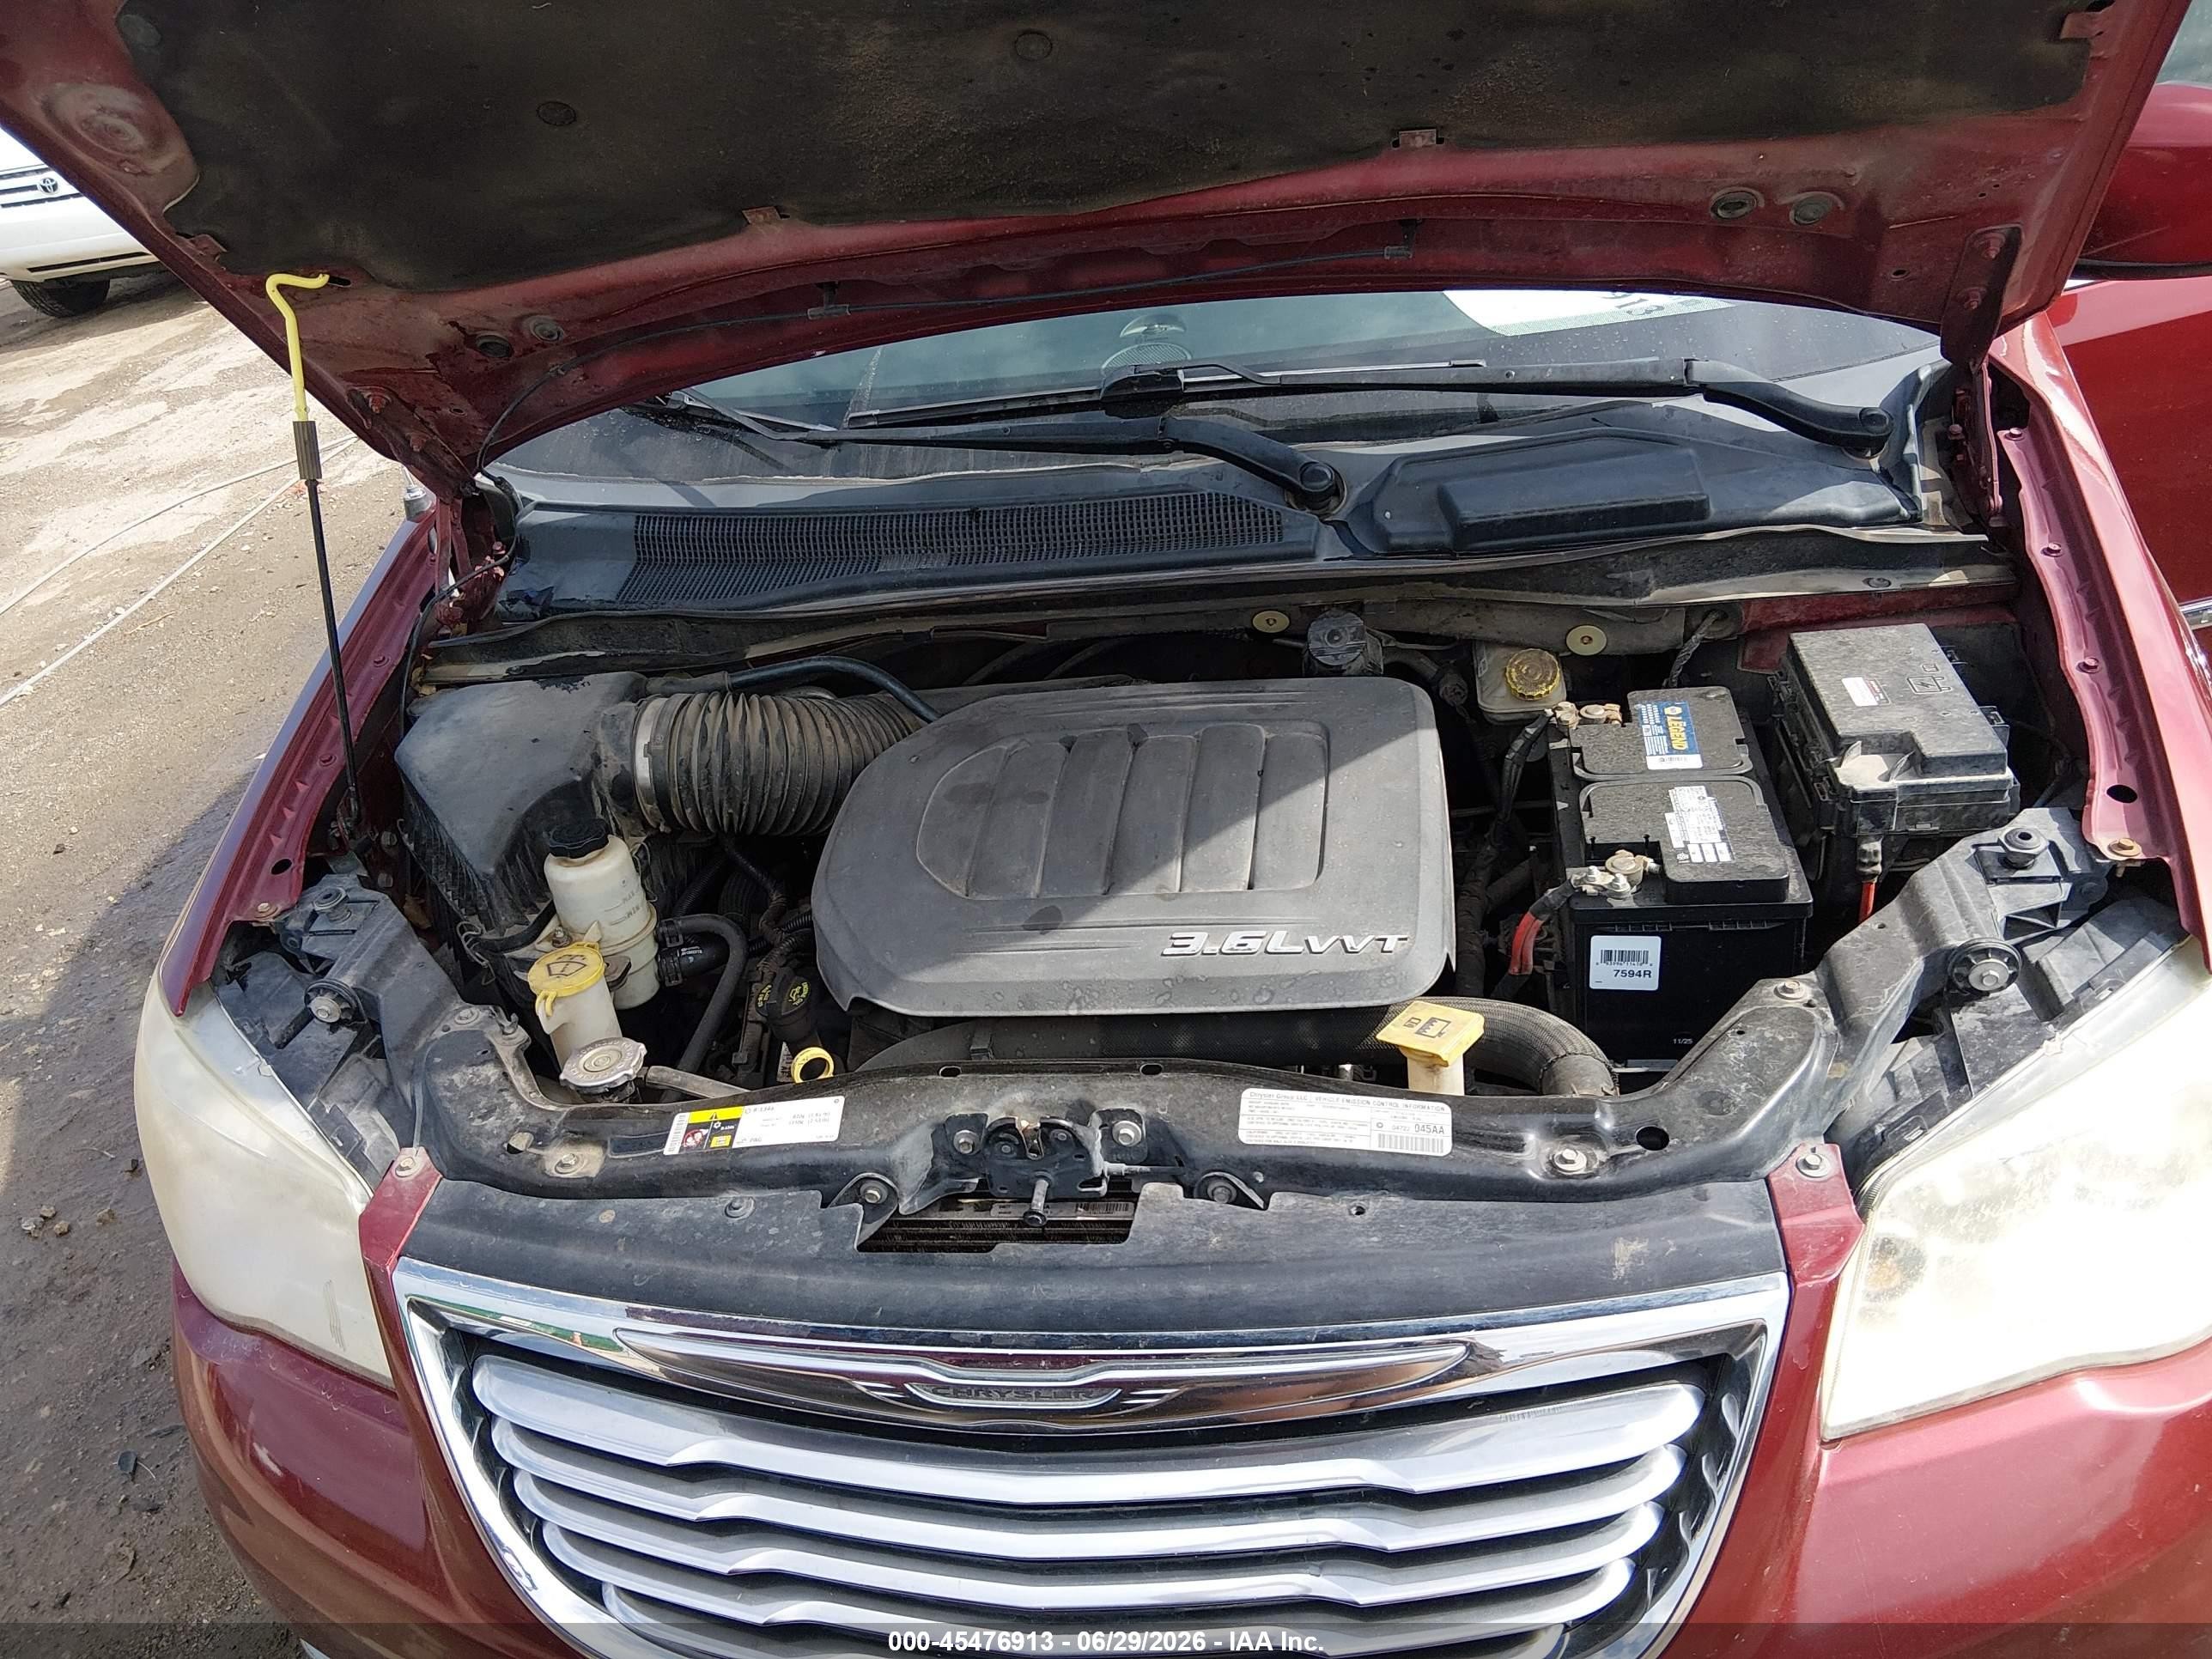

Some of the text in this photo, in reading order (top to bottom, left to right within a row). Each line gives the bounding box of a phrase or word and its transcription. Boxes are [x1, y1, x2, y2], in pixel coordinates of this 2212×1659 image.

[1613, 969, 1652, 979] 7594R
[1402, 1103, 1445, 1112] INFORMATION
[1414, 1123, 1445, 1134] 045AA
[932, 1387, 1095, 1400] CHRYSLER
